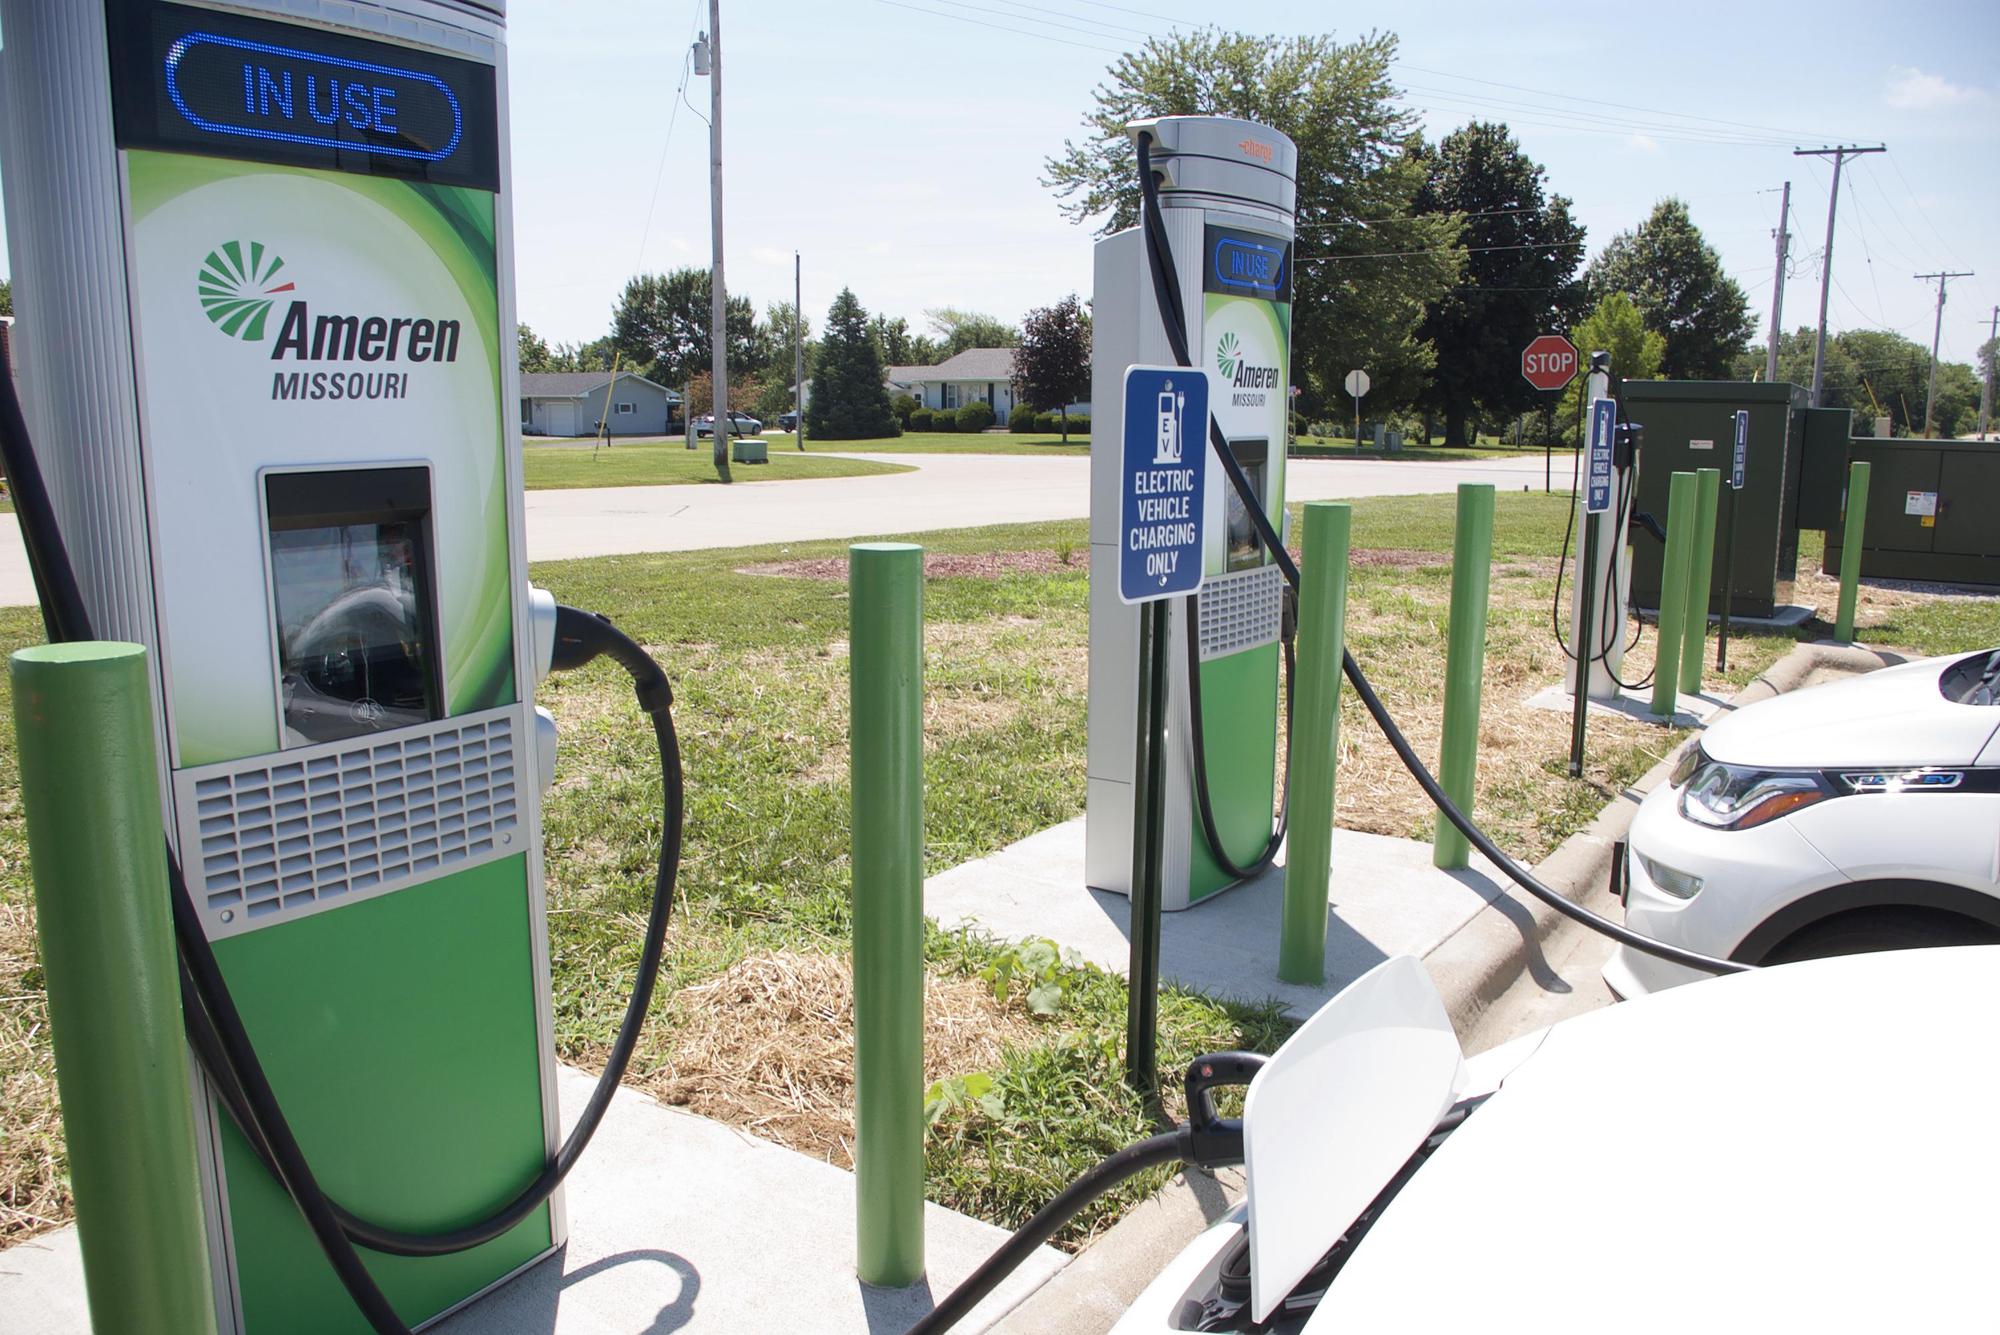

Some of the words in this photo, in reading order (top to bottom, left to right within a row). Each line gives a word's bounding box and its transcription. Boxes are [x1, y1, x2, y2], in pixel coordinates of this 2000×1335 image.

[243, 64, 294, 119] IN
[307, 74, 398, 134] USE
[1231, 251, 1244, 275] IN
[1245, 254, 1270, 280] USE
[270, 300, 461, 362] Ameren
[1233, 360, 1279, 389] Ameren
[1526, 352, 1573, 374] STOP
[271, 372, 409, 401] MISSOURI
[1231, 392, 1266, 408] MISSOURI
[1134, 469, 1195, 495] ELECTRIC
[1138, 496, 1190, 522] VEHICLE
[1130, 523, 1195, 551] CHARGING
[1146, 551, 1179, 576] ONLY
